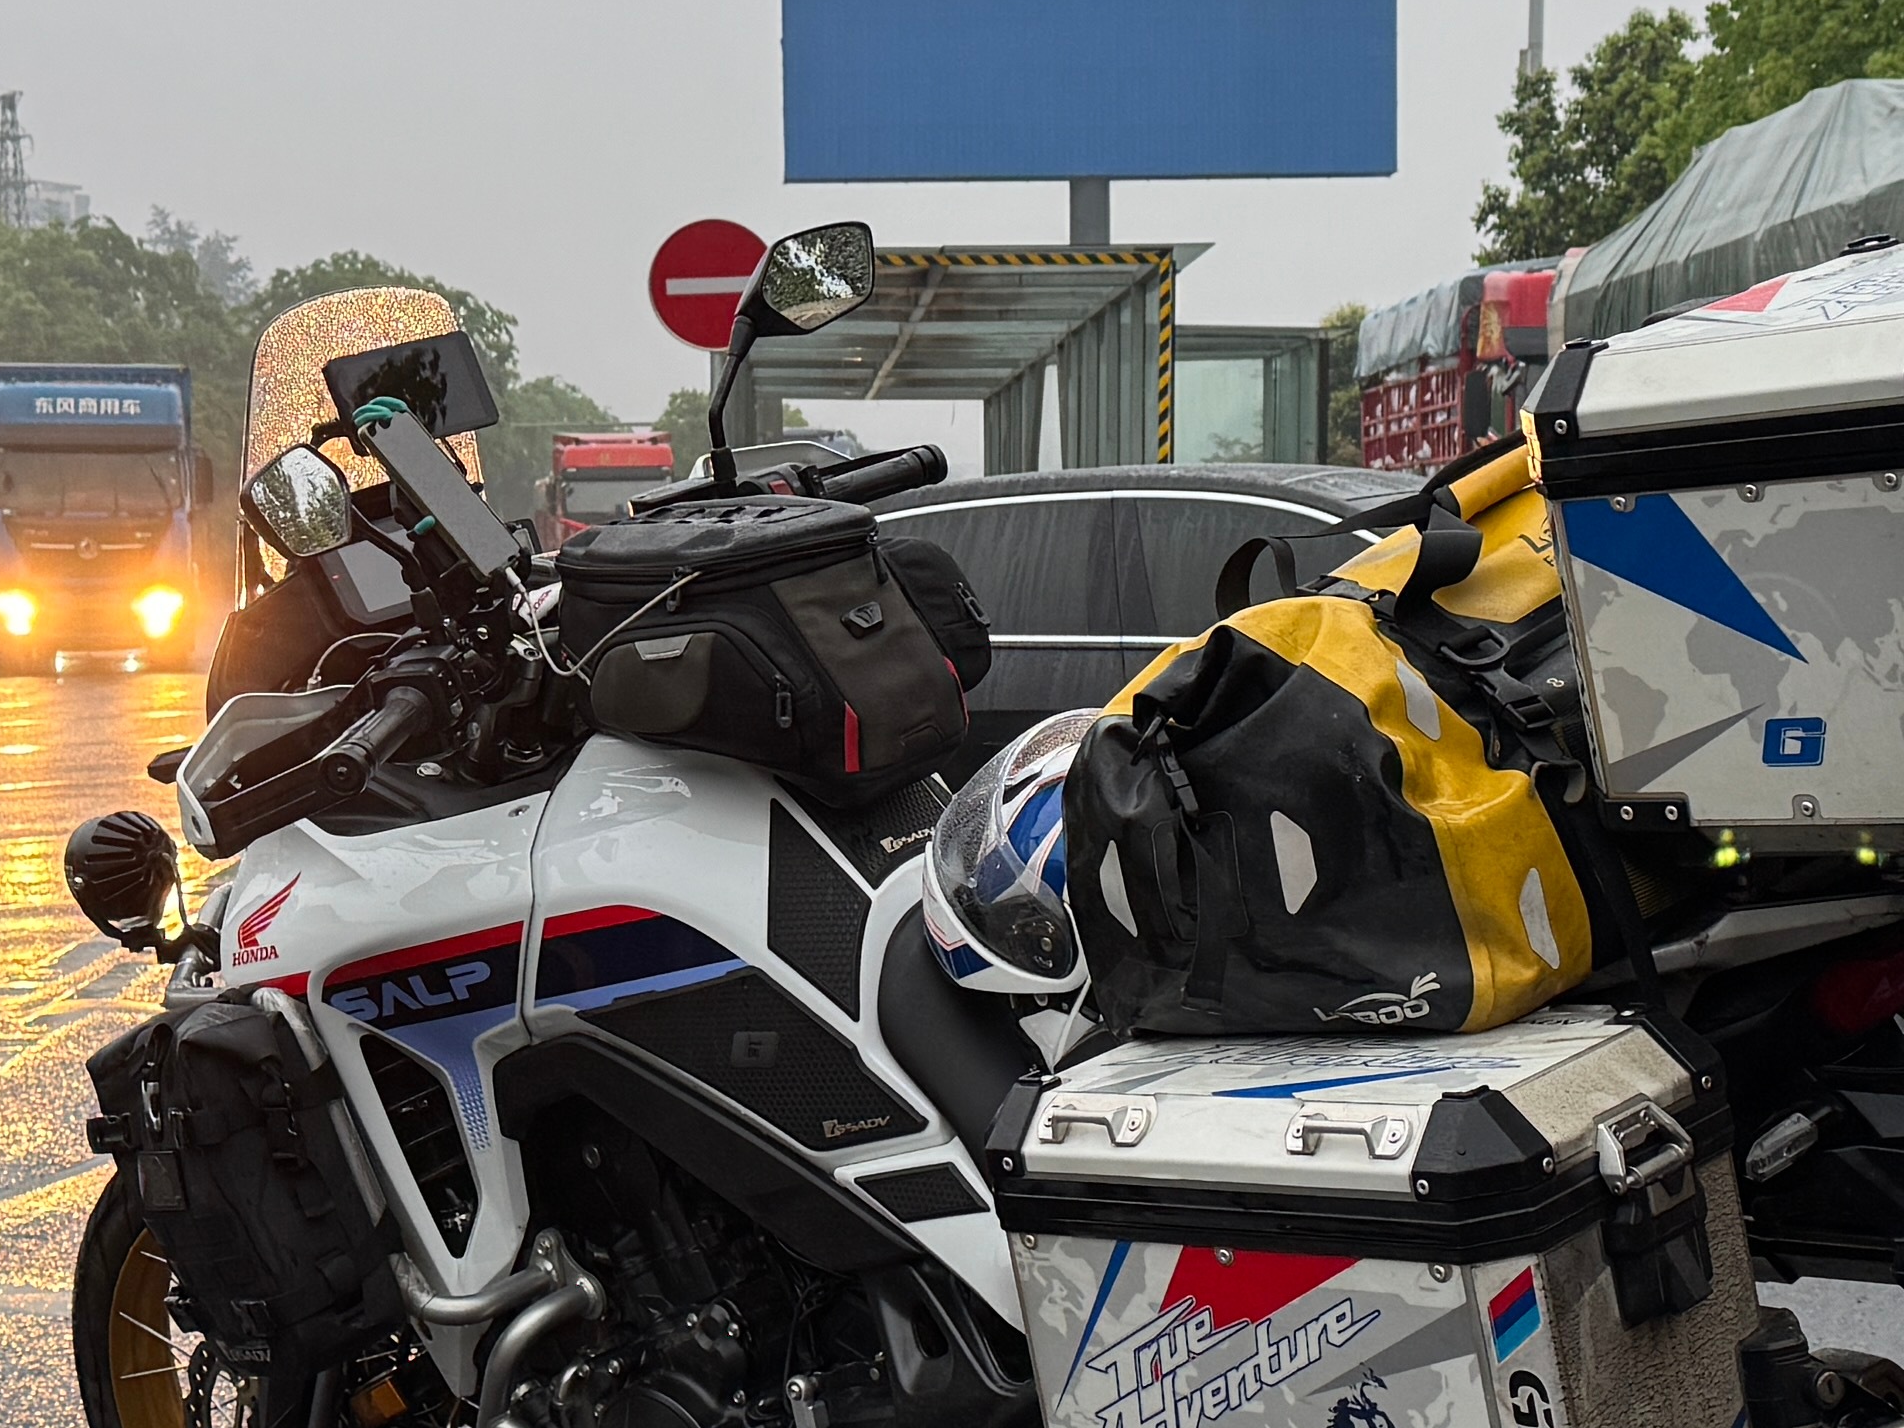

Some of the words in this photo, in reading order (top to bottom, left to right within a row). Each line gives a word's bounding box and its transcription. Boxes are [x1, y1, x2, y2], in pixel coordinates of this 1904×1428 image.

[34, 396, 142, 415] 东风商用车
[232, 945, 279, 967] HONDA
[330, 961, 491, 1022] SALP
[1085, 1296, 1250, 1398] True
